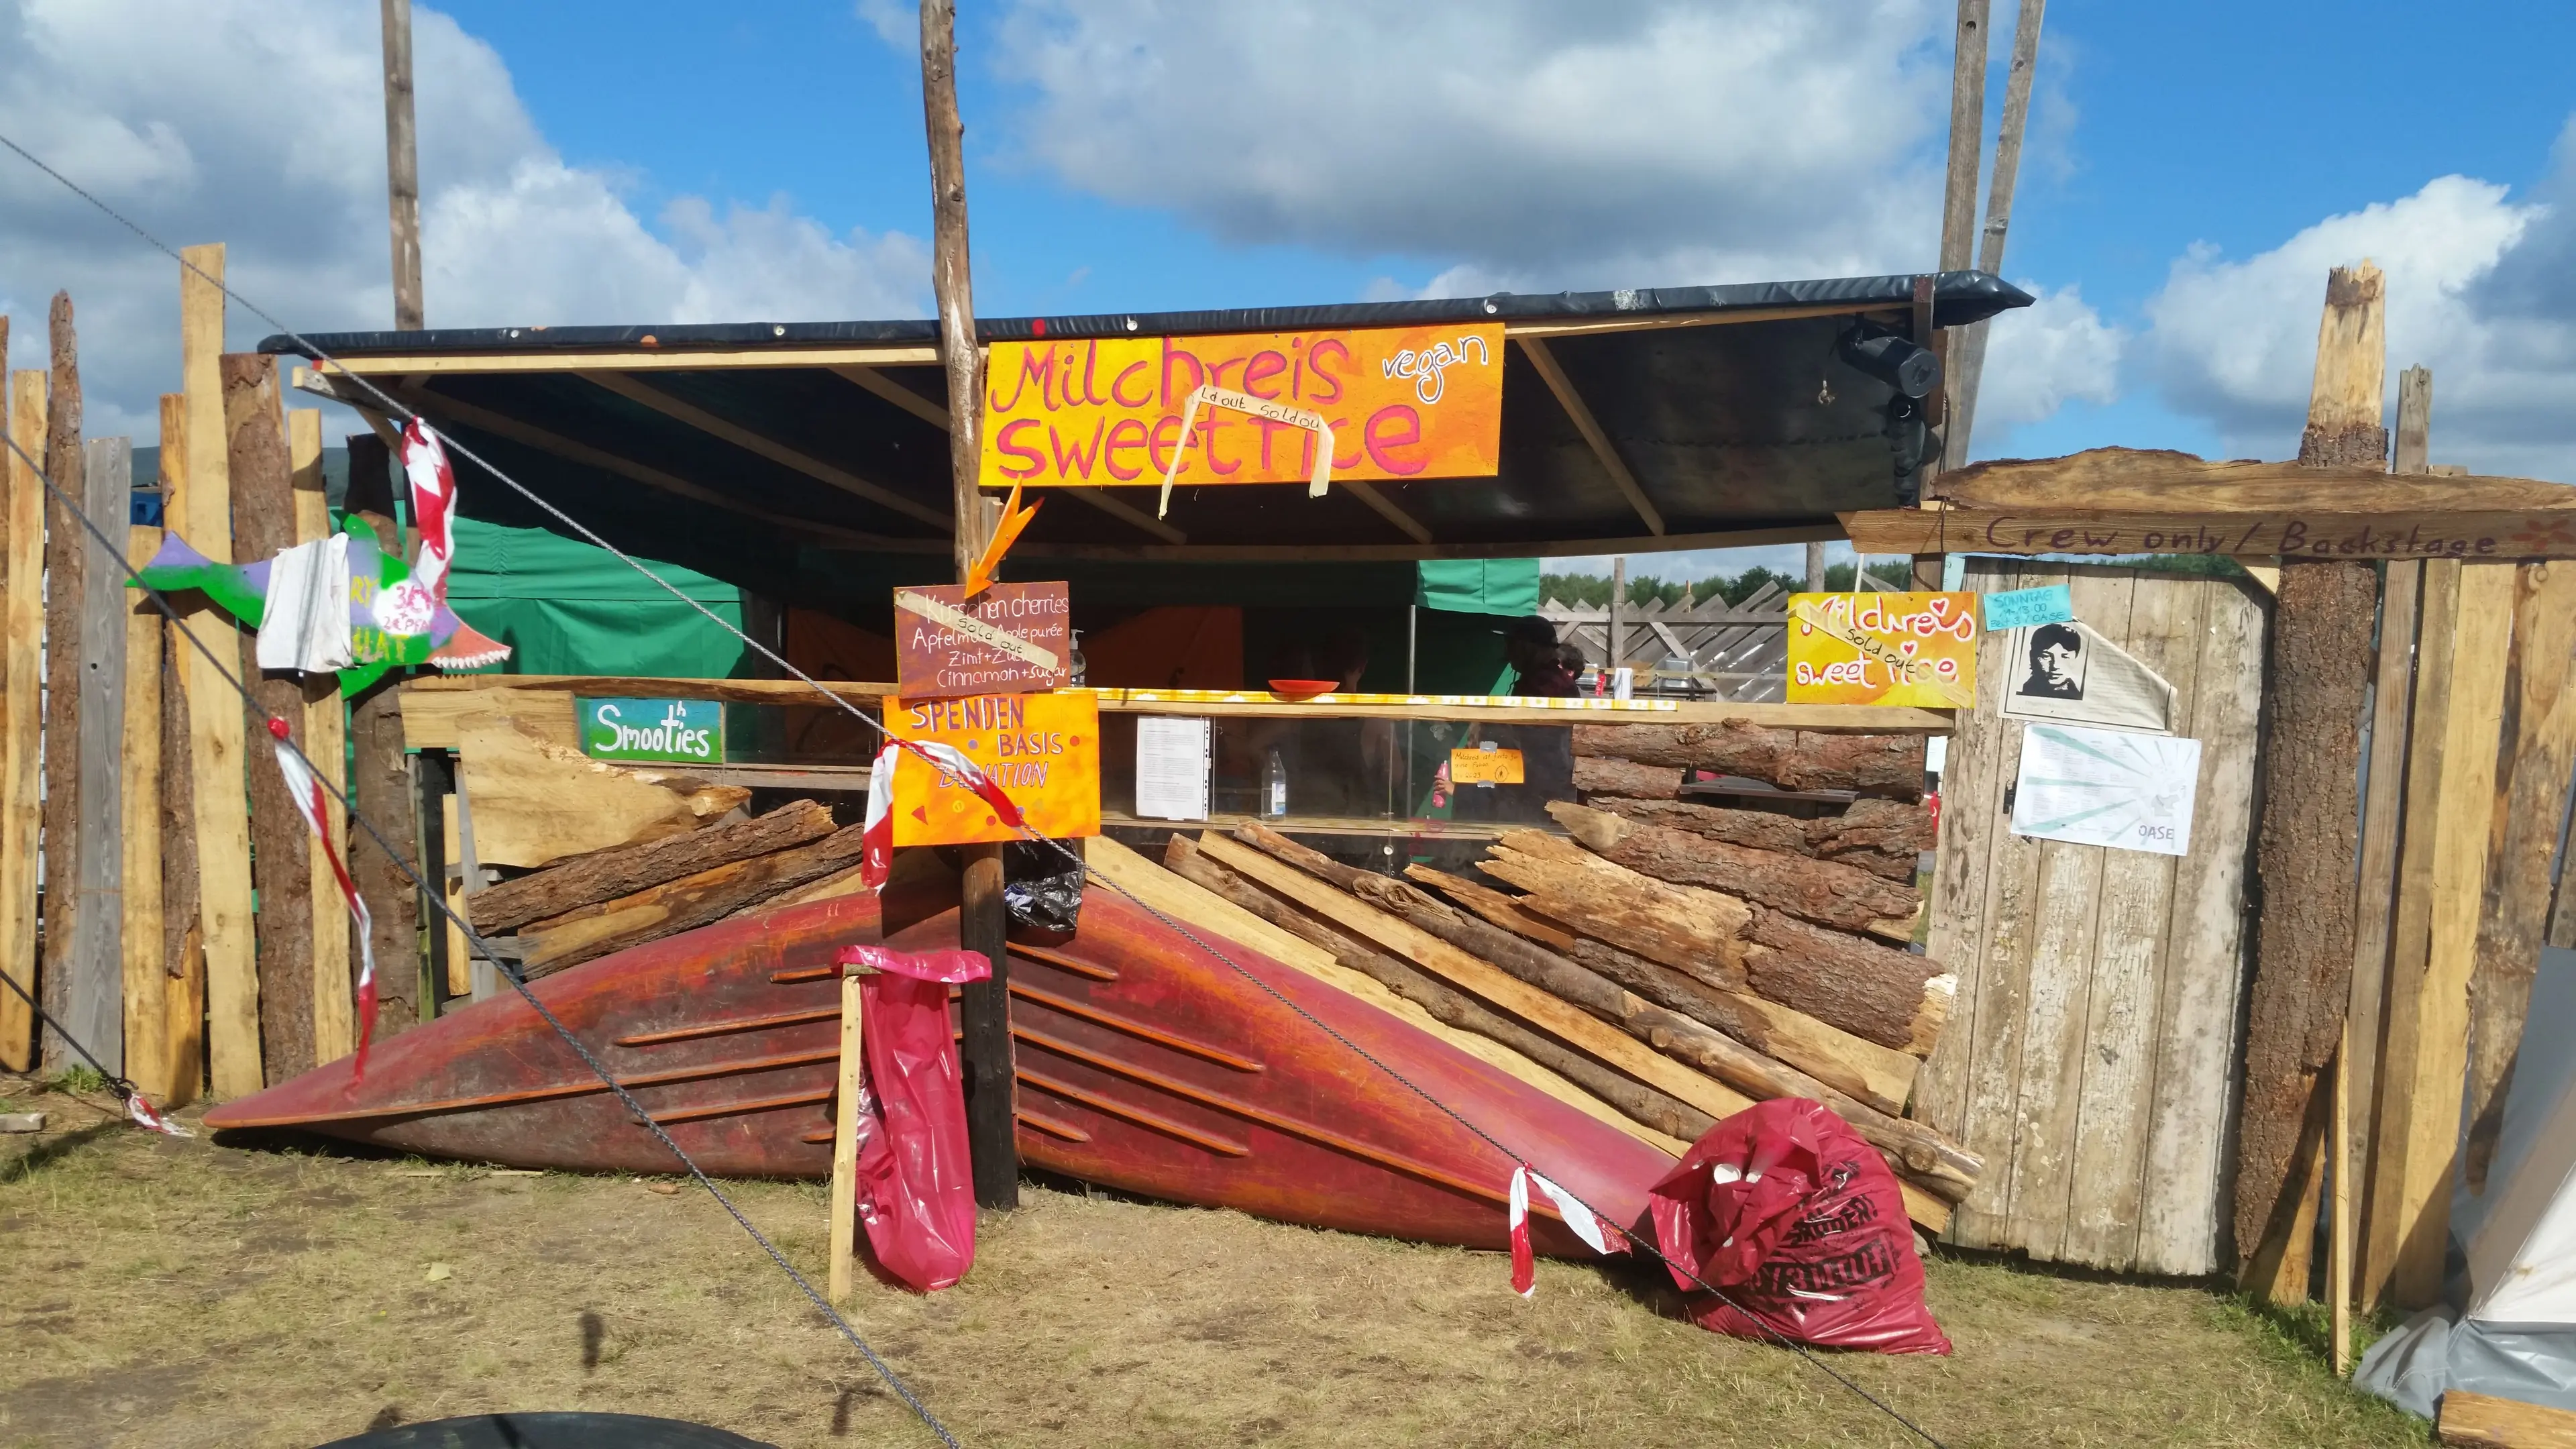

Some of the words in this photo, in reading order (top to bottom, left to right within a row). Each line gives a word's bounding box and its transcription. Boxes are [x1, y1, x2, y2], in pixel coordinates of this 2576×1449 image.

[1382, 334, 1489, 404] vegan
[1221, 396, 1246, 409] out
[1986, 516, 2118, 549] Crew
[2277, 520, 2497, 557] Backstage
[926, 592, 1008, 624] Kirschen
[1011, 590, 1070, 617] cherries
[1993, 590, 2053, 608] SONNTAG
[2033, 611, 2065, 623] OASE
[1030, 623, 1064, 644] purée
[1000, 639, 1023, 653] out
[1795, 651, 1877, 689] sweet
[1884, 653, 1916, 674] out
[910, 697, 1024, 733] SPENDEN
[998, 732, 1064, 757] BASIS
[2139, 824, 2174, 840] OASE
